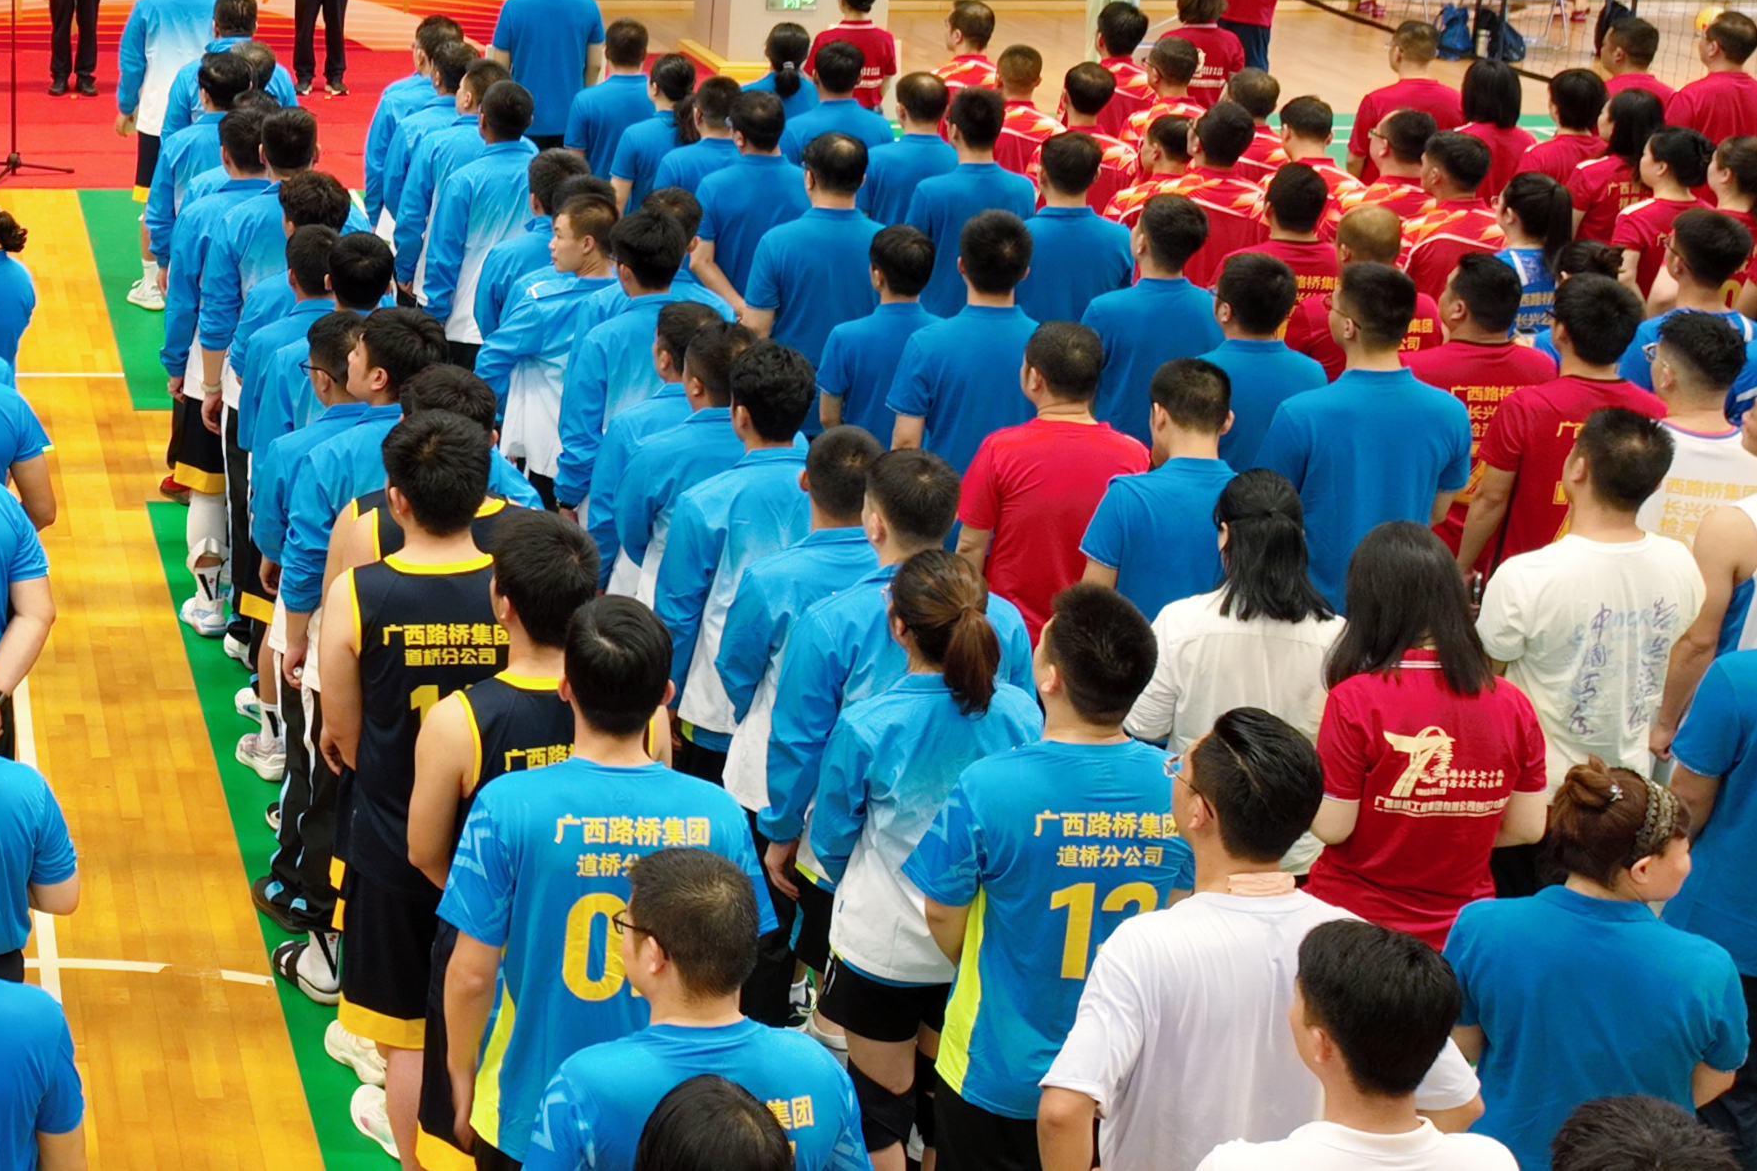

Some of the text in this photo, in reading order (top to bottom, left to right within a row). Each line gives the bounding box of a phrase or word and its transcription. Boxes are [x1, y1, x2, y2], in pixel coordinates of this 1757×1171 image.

[1450, 385, 1520, 402] 广西路桥
[383, 624, 510, 646] 广西路桥集团
[404, 647, 497, 666] 道桥分公司
[554, 814, 711, 847] 广西路桥集团
[1033, 810, 1181, 839] 广西路桥集团
[1056, 845, 1164, 868] 道桥分公司
